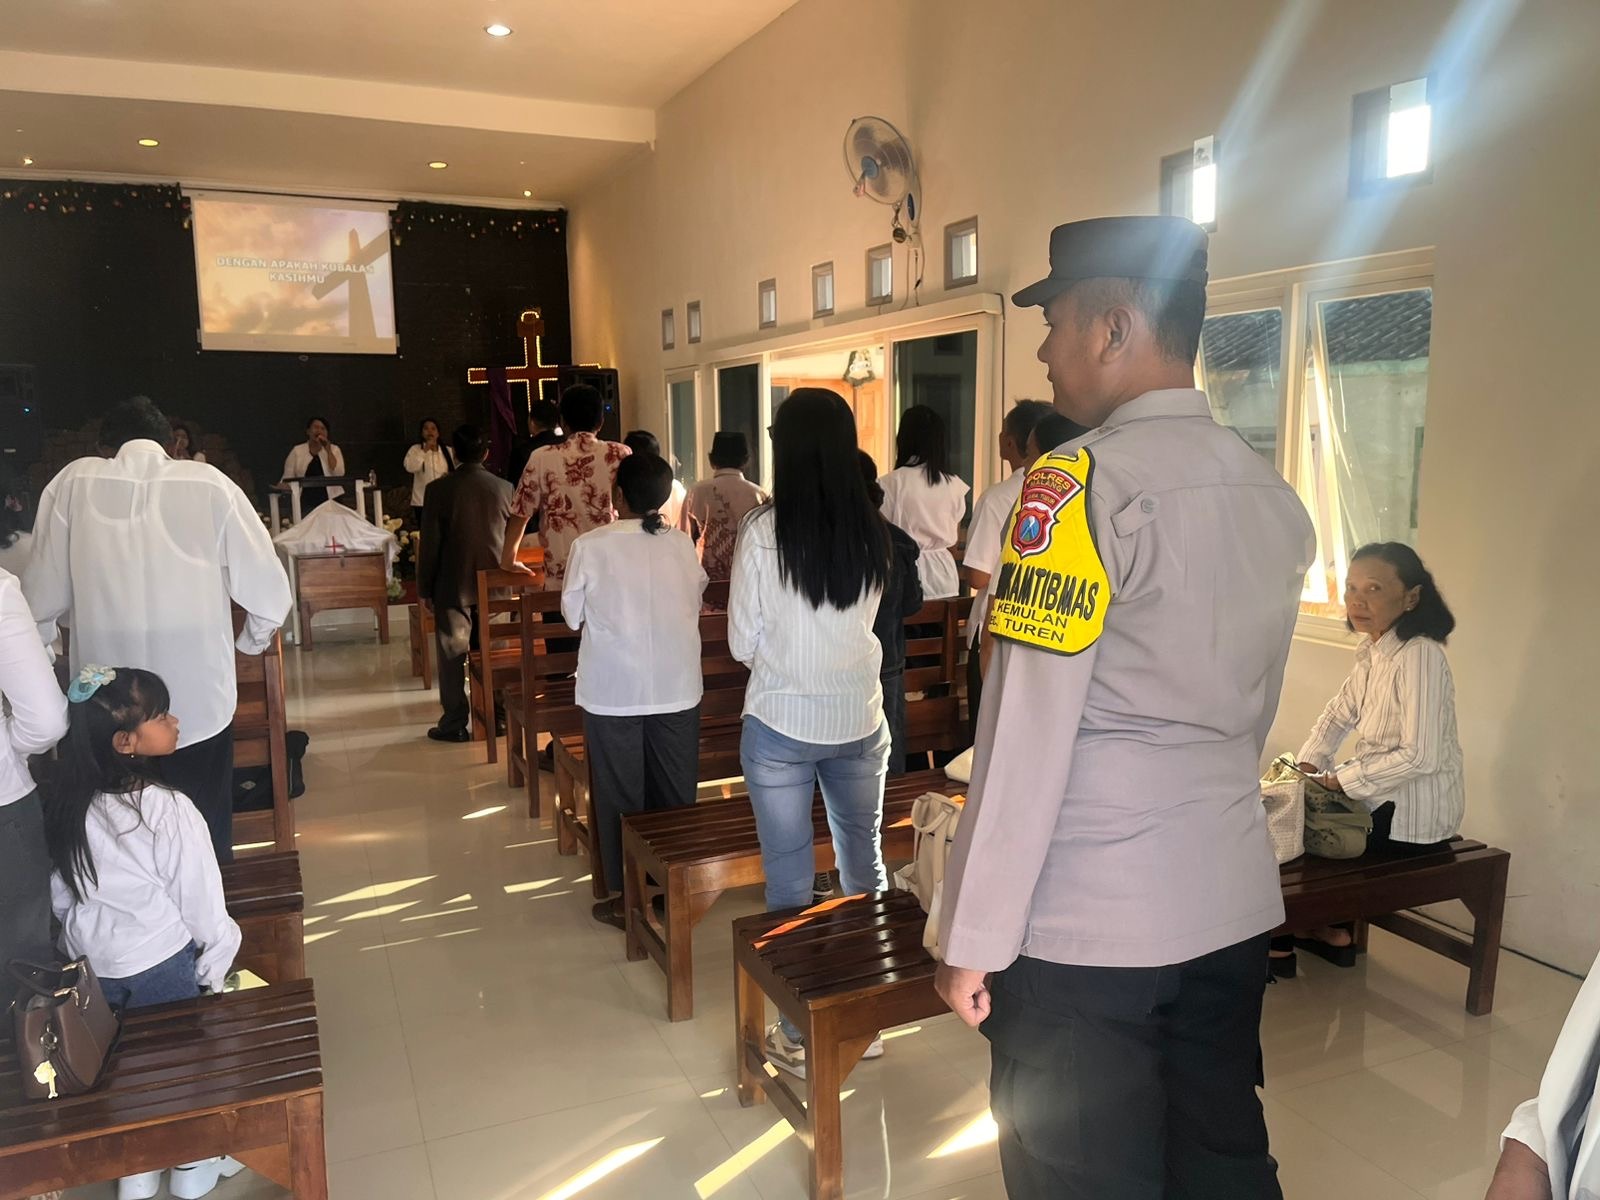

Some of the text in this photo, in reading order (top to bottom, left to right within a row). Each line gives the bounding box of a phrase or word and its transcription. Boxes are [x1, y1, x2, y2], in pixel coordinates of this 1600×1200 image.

[216, 257, 375, 274] DENGAN APAKAH KUBALAS
[269, 272, 326, 284] KASIHMU
[1026, 472, 1072, 490] POLRES
[995, 562, 1100, 621] KAMTIBMAS
[996, 602, 1068, 629] KEMULAN
[1004, 618, 1065, 644] TUREN
